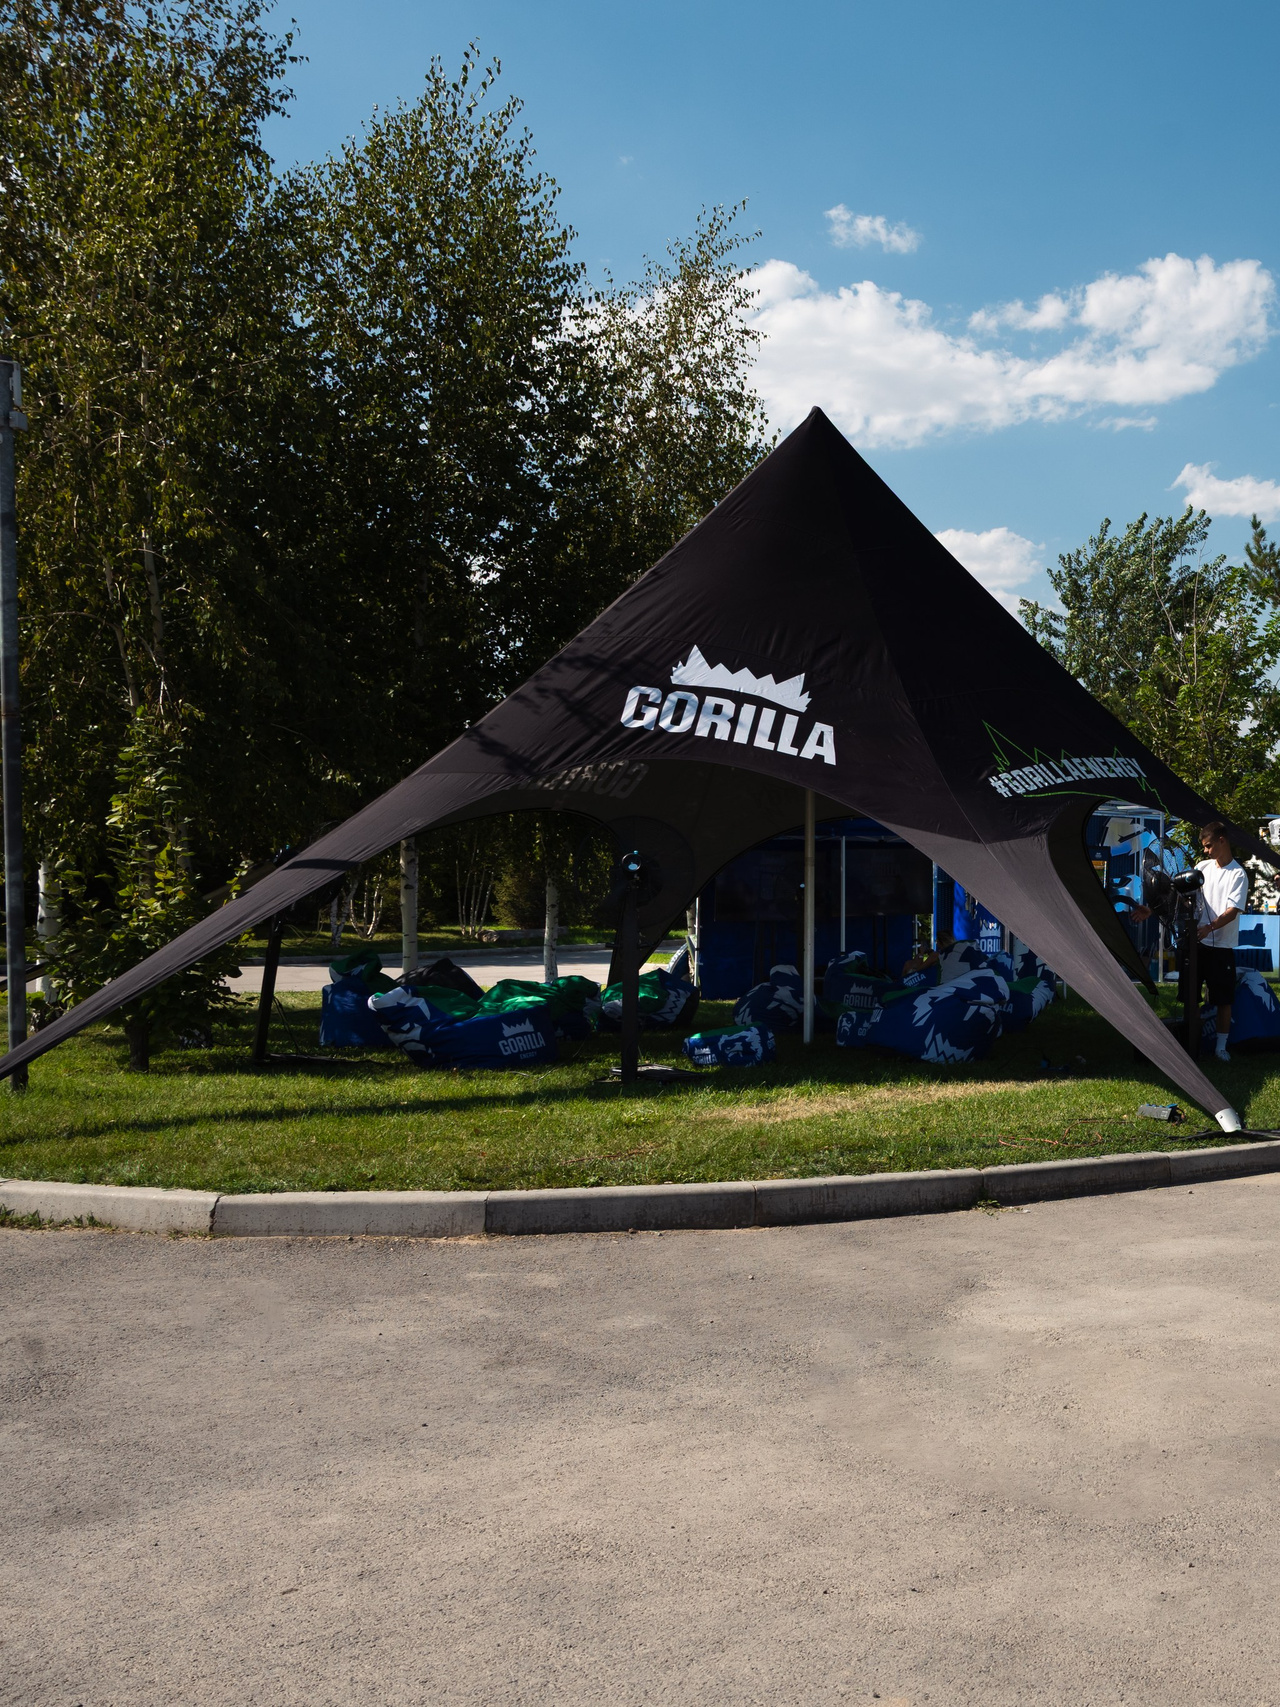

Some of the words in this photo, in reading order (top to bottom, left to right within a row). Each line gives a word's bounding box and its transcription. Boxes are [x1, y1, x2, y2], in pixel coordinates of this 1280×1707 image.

[620, 685, 837, 767] GORILLA
[987, 756, 1147, 798] #GORILLAENERGY
[498, 1031, 546, 1056] GORILLA
[519, 1051, 538, 1060] ENERGY
